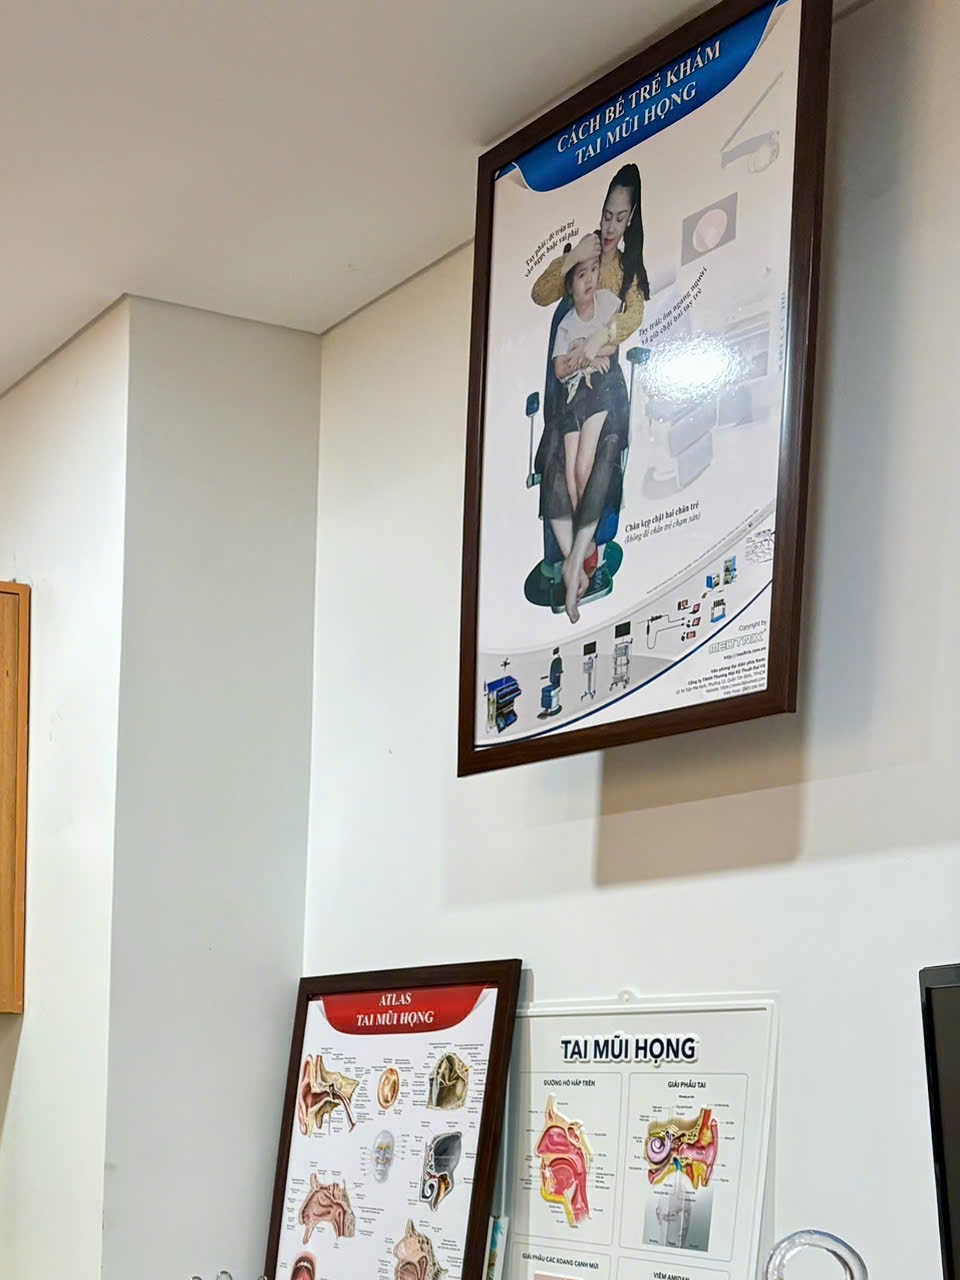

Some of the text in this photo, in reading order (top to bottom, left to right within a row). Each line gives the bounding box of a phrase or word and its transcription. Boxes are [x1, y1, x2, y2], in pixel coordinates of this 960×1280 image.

[557, 113, 601, 152] CÁCH
[628, 72, 662, 109] TRẺ
[665, 40, 721, 88] KHÁM
[575, 81, 697, 165] TAI MŨI HỌNG
[625, 521, 640, 533] Chân
[651, 512, 665, 524] chặt
[665, 508, 675, 519] hai
[675, 504, 690, 516] chân
[379, 992, 412, 1006] ATLAS
[356, 1010, 434, 1028] TAI MŨI HỌNG
[561, 1035, 696, 1064] TAI MŨI HỌNG
[697, 1080, 707, 1088] TAI
[545, 1255, 556, 1264] CÁC
[653, 1271, 667, 1280] VIÊM
